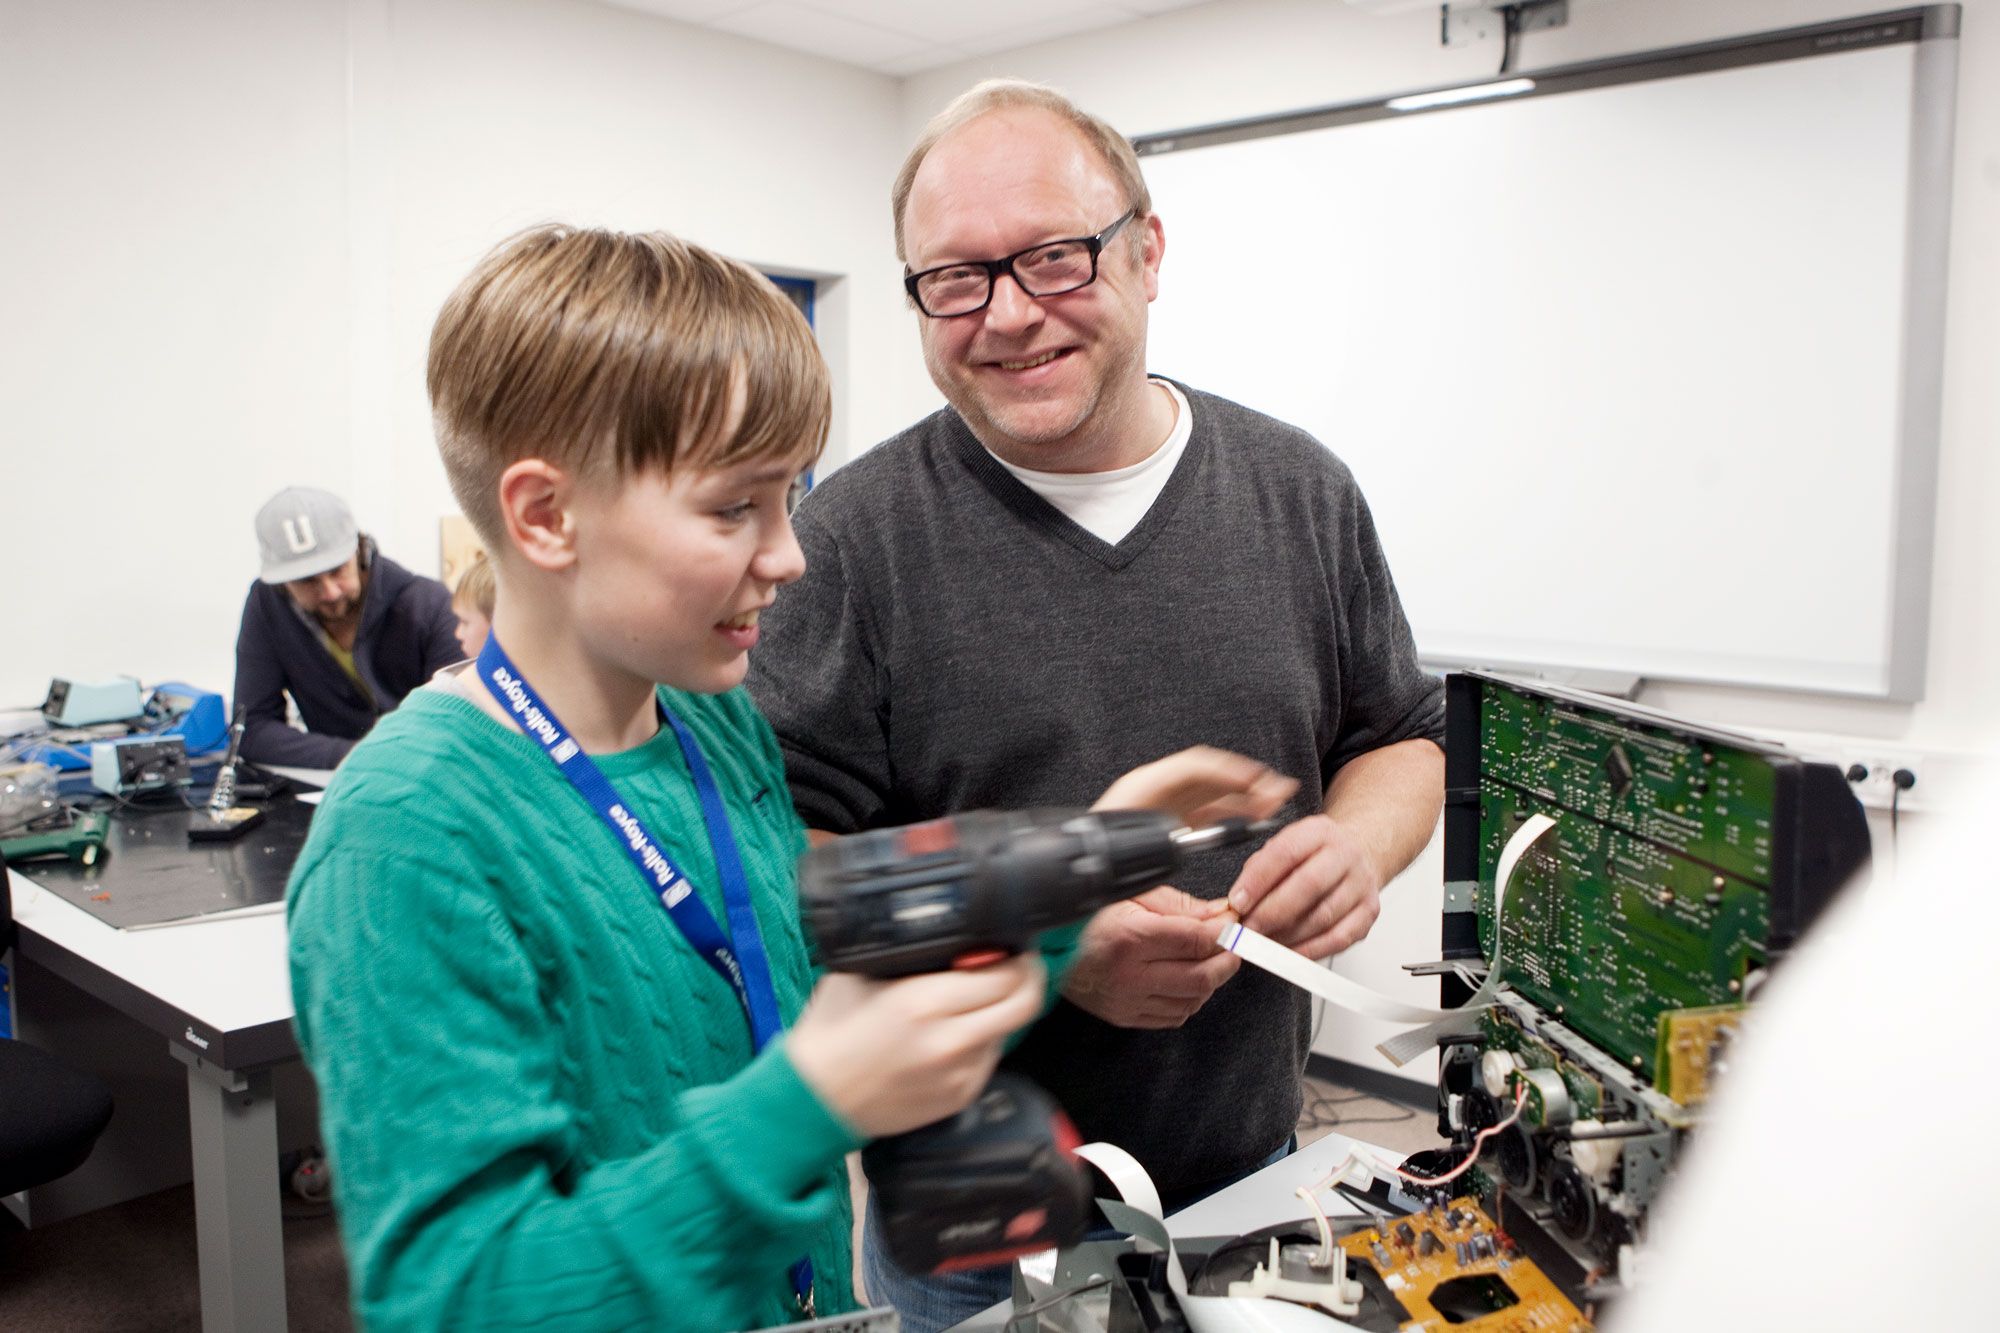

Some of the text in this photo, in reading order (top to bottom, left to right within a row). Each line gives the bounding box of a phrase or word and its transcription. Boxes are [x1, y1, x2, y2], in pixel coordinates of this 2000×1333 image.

[282, 514, 318, 554] U
[491, 666, 560, 746] Rolls-Royce
[608, 803, 674, 887] Rolls-Royce
